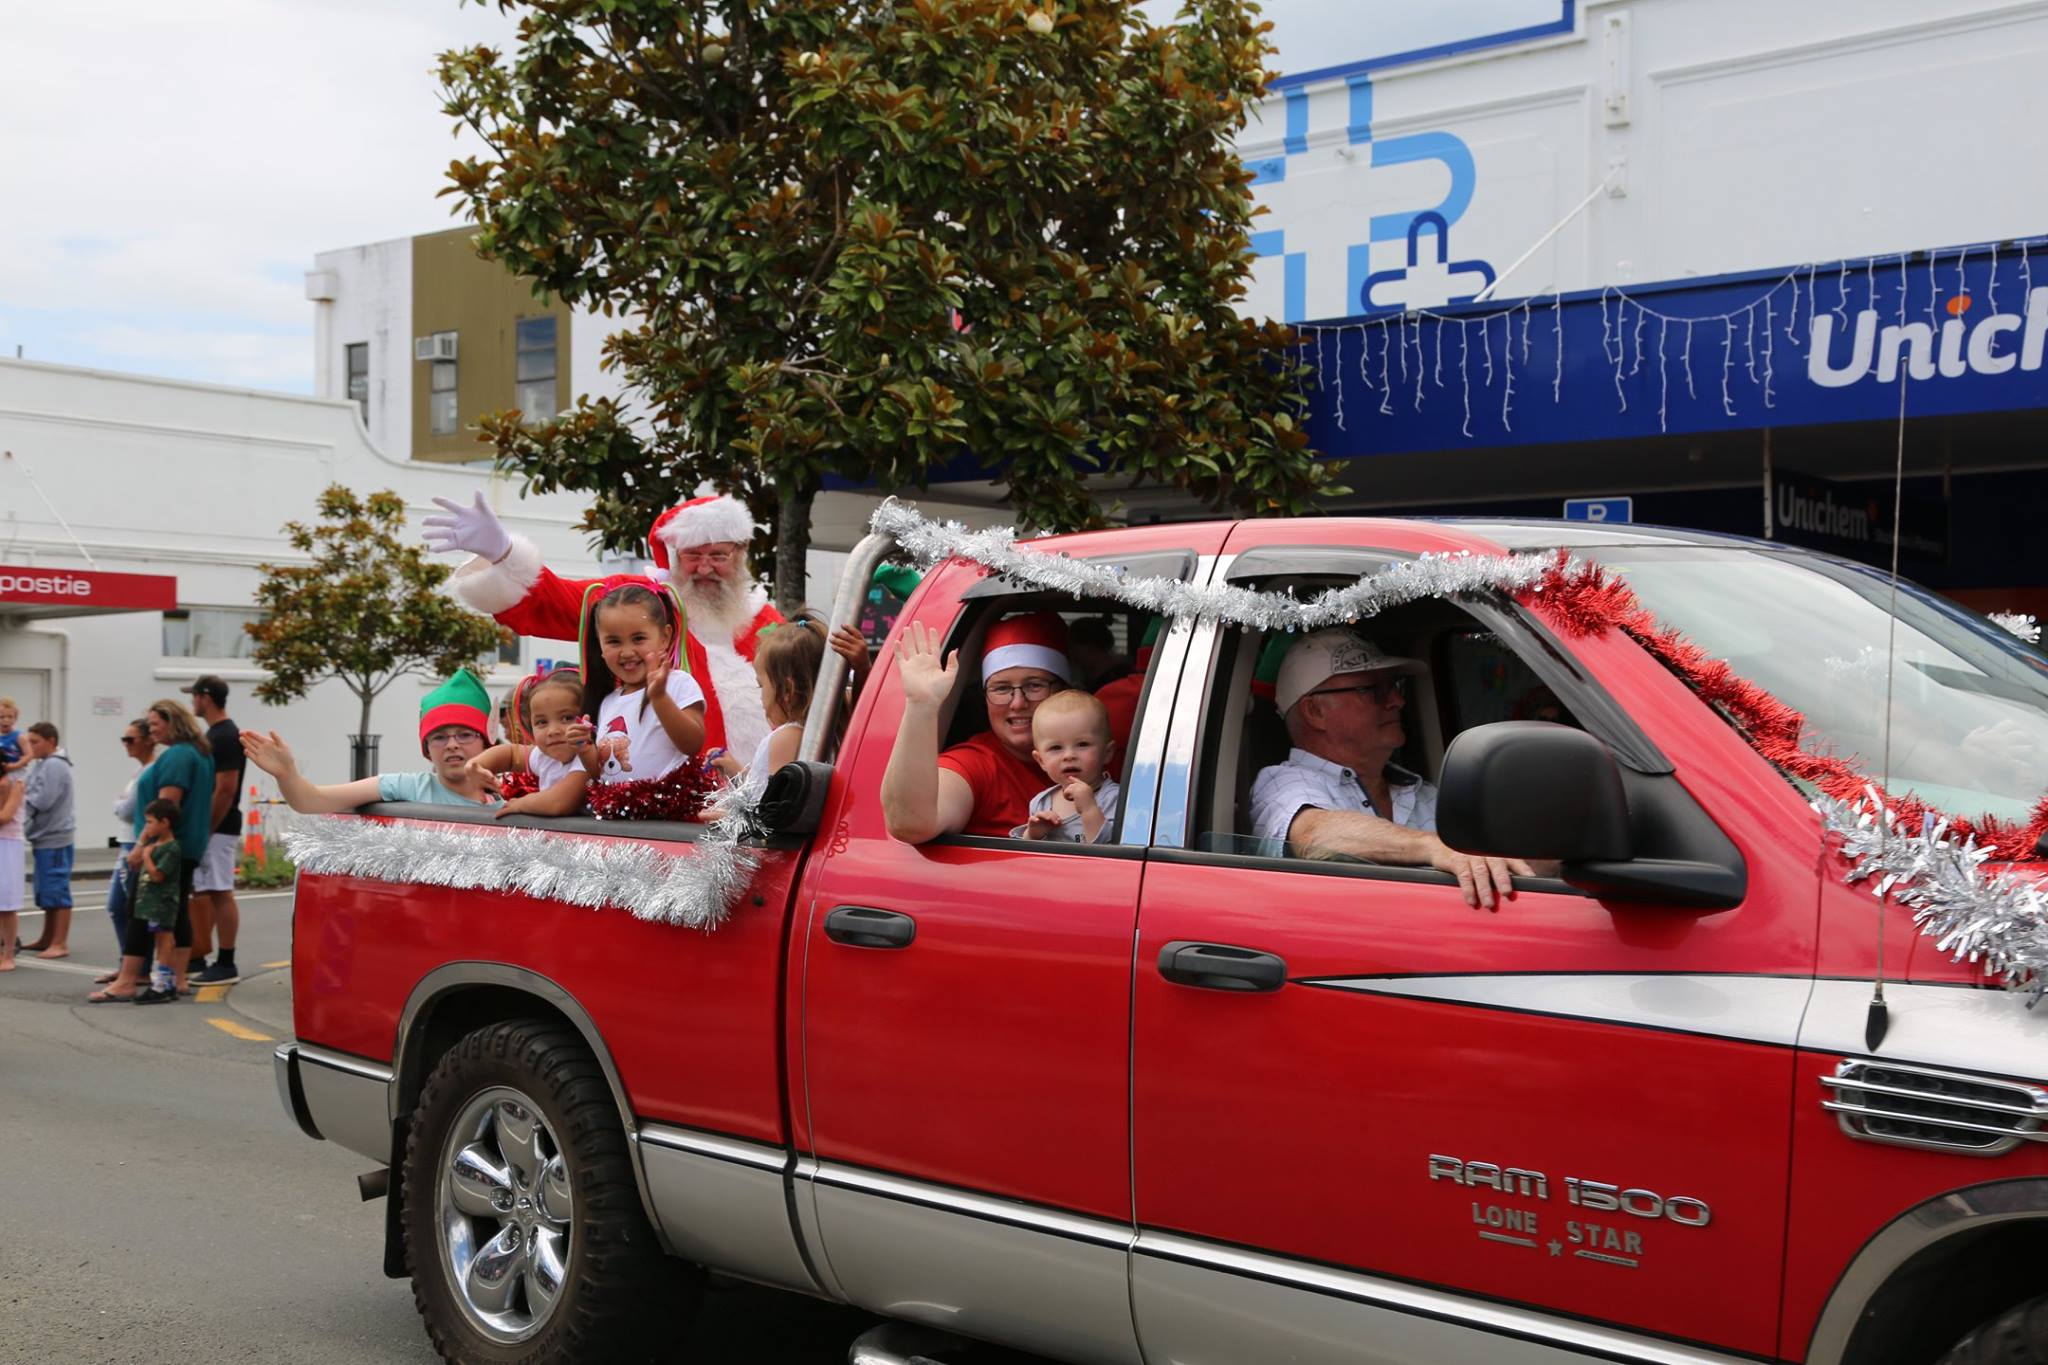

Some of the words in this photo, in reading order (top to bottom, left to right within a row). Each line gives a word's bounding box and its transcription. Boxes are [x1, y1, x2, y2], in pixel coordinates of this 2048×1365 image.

[1778, 483, 1868, 541] Unichem
[0, 574, 91, 596] postie
[1429, 1153, 1548, 1200] RAM
[1564, 1176, 1711, 1227] 1500
[1472, 1202, 1538, 1235] LONE
[1566, 1221, 1643, 1255] STAR
